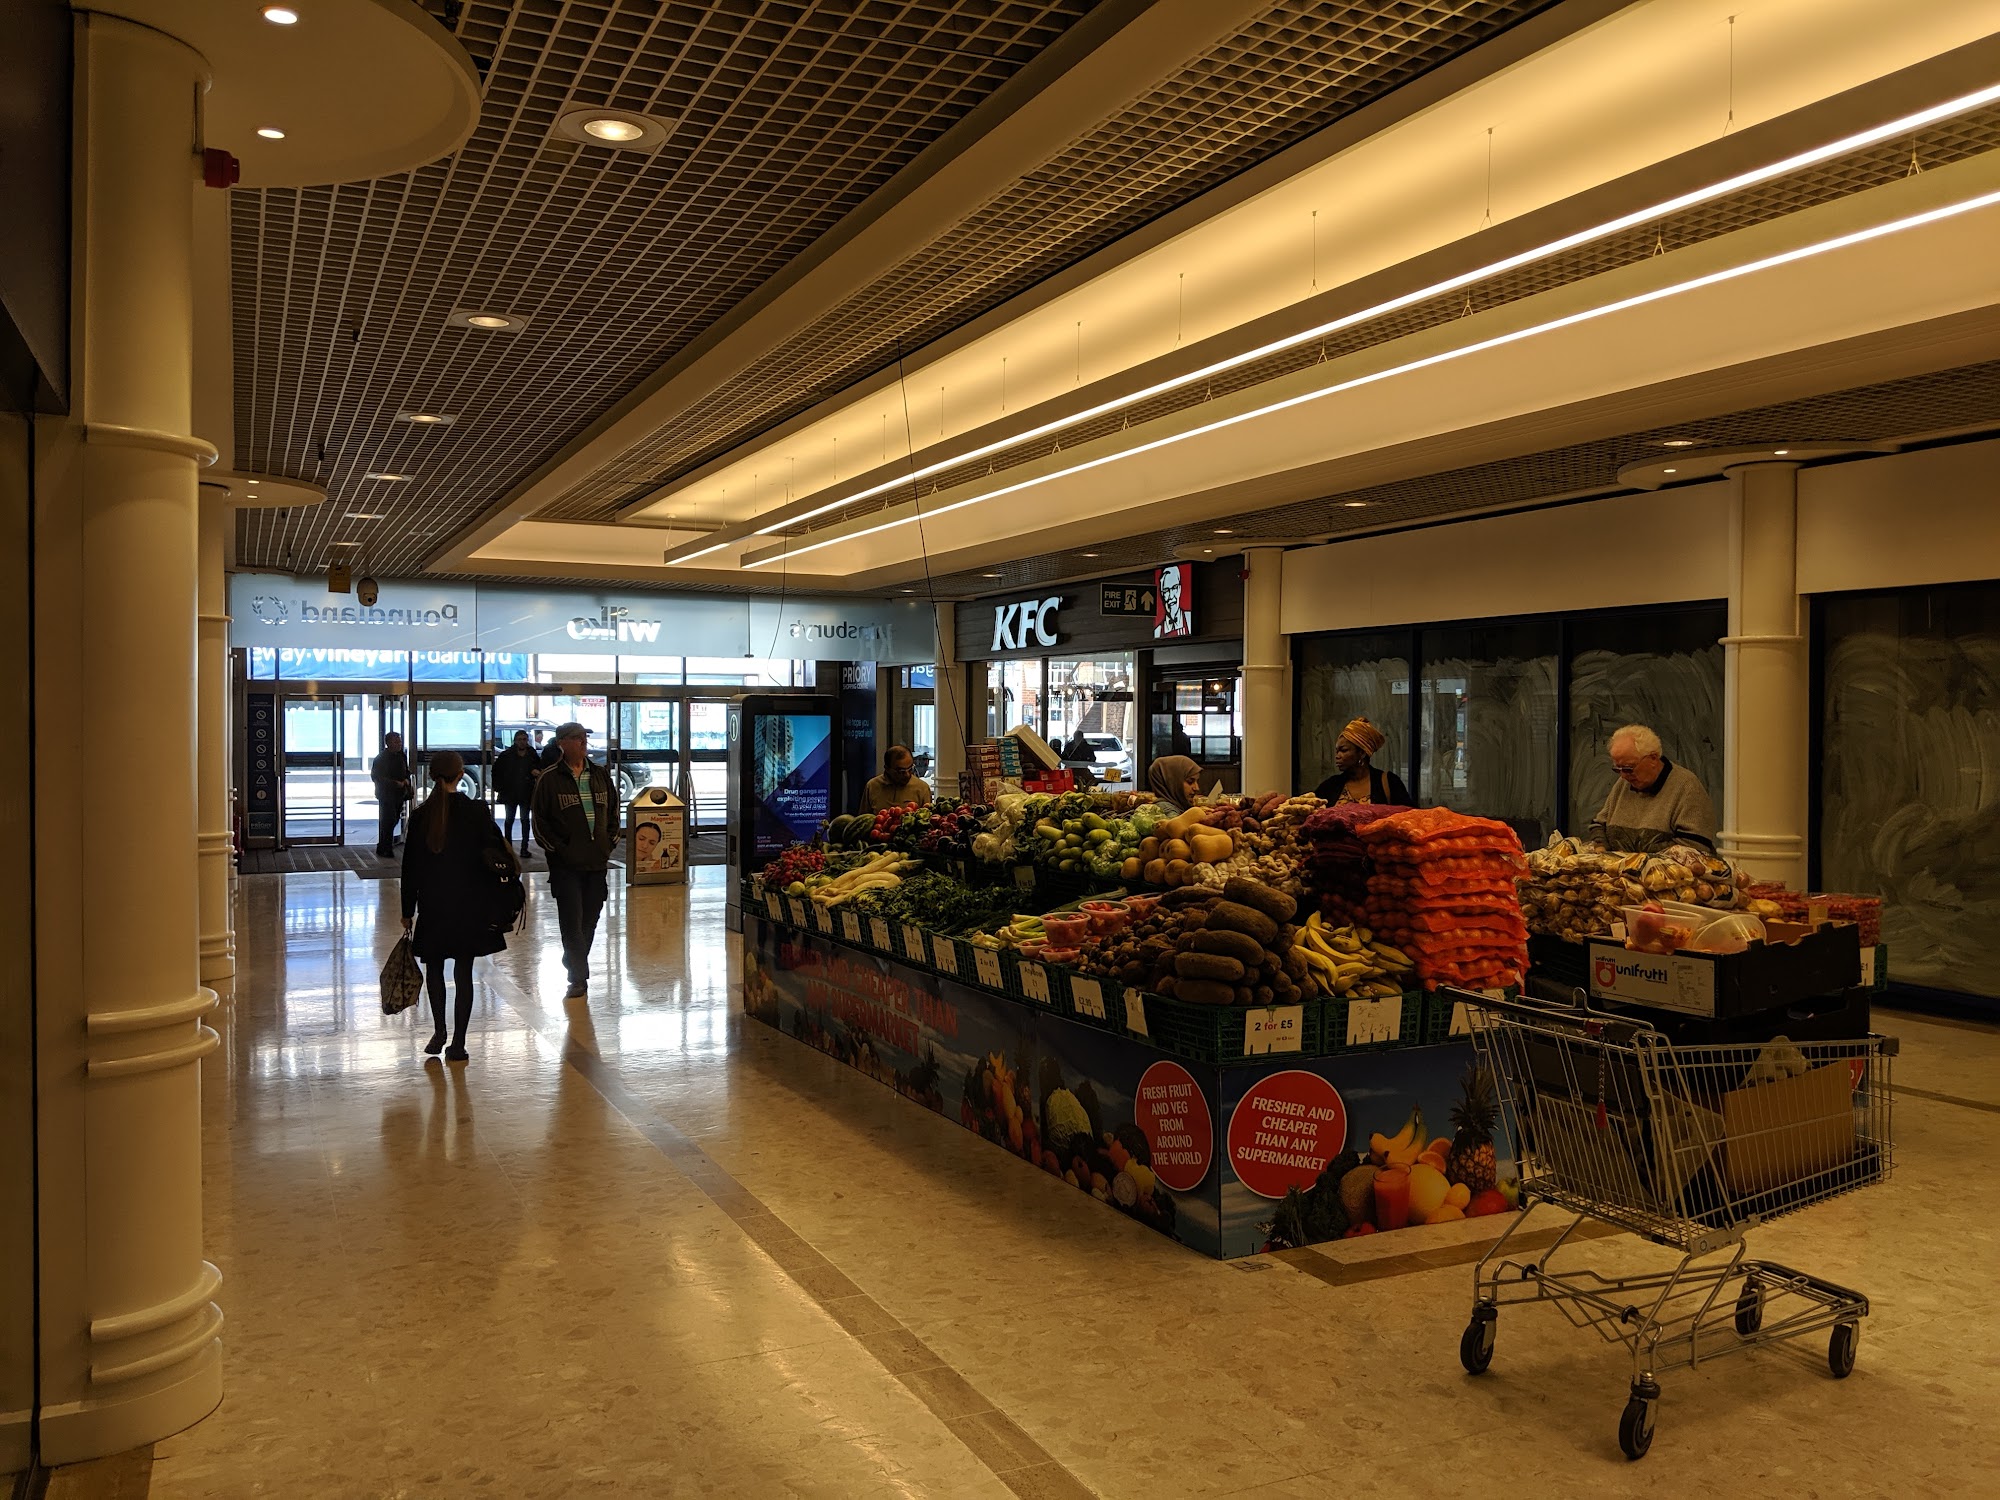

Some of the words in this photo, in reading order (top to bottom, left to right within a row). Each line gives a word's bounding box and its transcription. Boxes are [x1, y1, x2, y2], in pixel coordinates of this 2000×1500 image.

[1104, 590, 1121, 599] FIRE
[1104, 600, 1121, 609] EXIT
[990, 596, 1060, 651] KFC
[842, 661, 872, 683] PRIORY
[1615, 963, 1668, 982] unifrutti
[831, 987, 920, 1057] SUPERMARKET
[912, 987, 959, 1040] THAN
[1254, 1022, 1261, 1031] 2
[1264, 1021, 1278, 1031] for
[1280, 1019, 1293, 1029] £5
[1142, 1085, 1168, 1100] FRESH
[1168, 1083, 1192, 1098] FRUIT
[1151, 1102, 1169, 1116] AND
[1170, 1101, 1188, 1114] VEG
[1251, 1096, 1306, 1118] FRESHER
[1308, 1106, 1336, 1121] AND
[1159, 1118, 1184, 1132] FROM
[1261, 1115, 1318, 1136] CHEAPER
[1157, 1135, 1193, 1149] AROUND
[1255, 1131, 1290, 1149] THAN
[1290, 1138, 1318, 1153] ANY
[1152, 1152, 1169, 1166] THE
[1170, 1151, 1202, 1165] WORLD
[1236, 1146, 1326, 1171] SUPERMARKET
